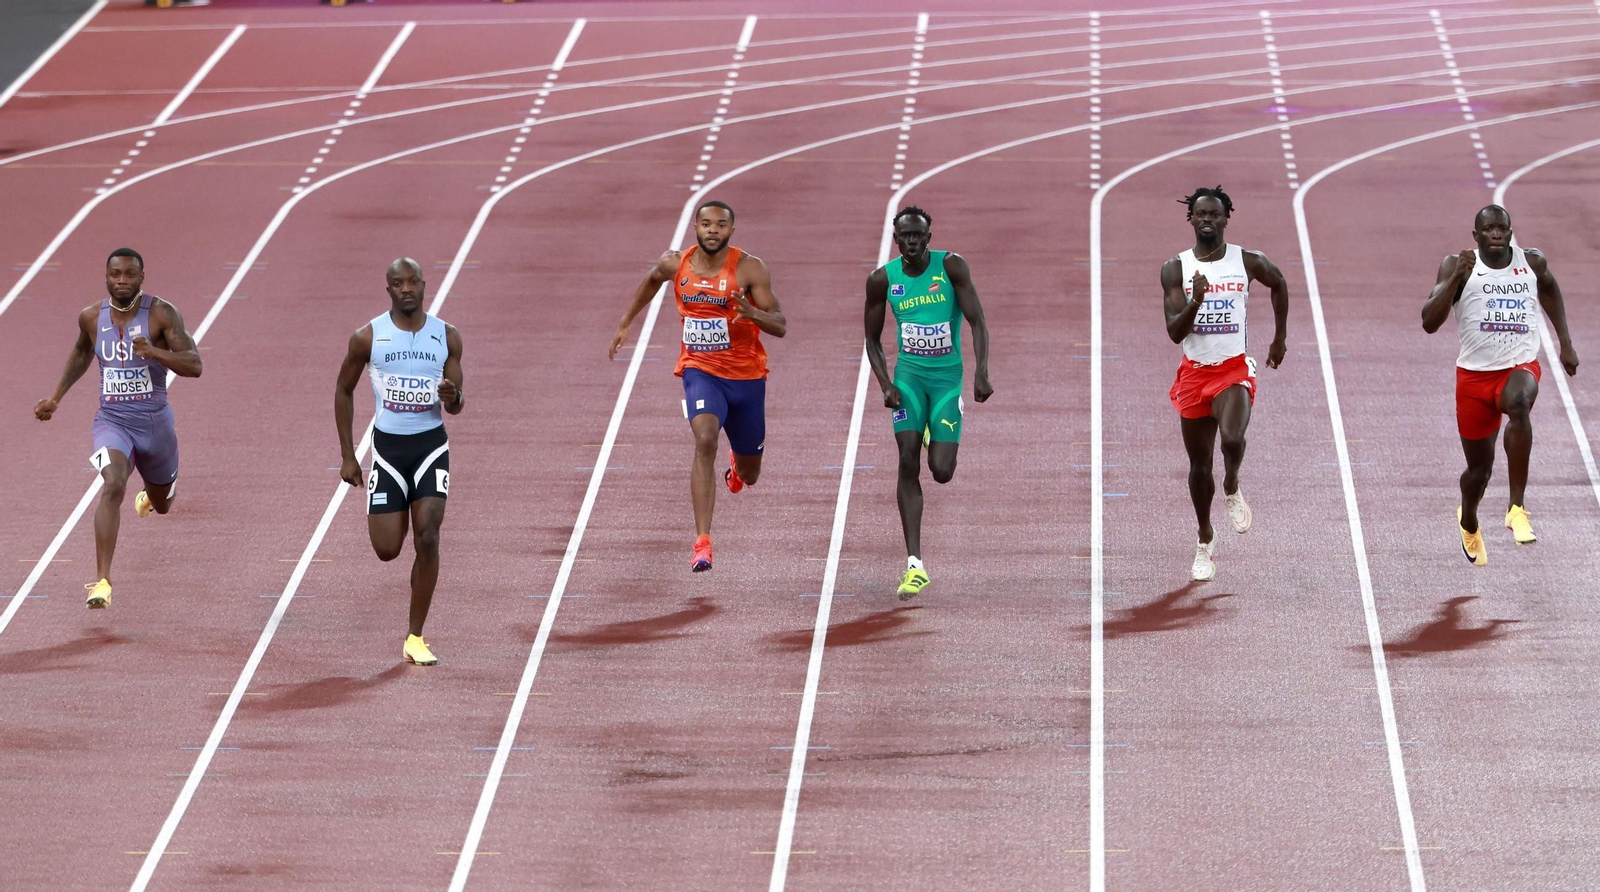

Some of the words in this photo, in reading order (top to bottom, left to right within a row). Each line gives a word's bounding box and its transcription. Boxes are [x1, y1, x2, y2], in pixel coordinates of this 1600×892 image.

[1185, 282, 1245, 296] FANCE
[1482, 282, 1529, 295] CANADA
[898, 293, 946, 311] AUSTRALIA
[1204, 299, 1235, 310] TDK
[1496, 299, 1526, 310] TDK
[1198, 312, 1231, 324] ZEZE
[692, 320, 723, 330] TDK
[914, 324, 946, 336] TDK
[685, 332, 727, 343] MO-AJOK
[907, 336, 946, 349] GOUT
[385, 350, 437, 363] BOTSWANA
[114, 369, 147, 380] TDK
[105, 380, 149, 393] LINDSEY
[397, 377, 431, 389] TDK
[386, 388, 431, 403] TEBOGO
[369, 474, 375, 490] 6
[442, 474, 448, 490] 6
